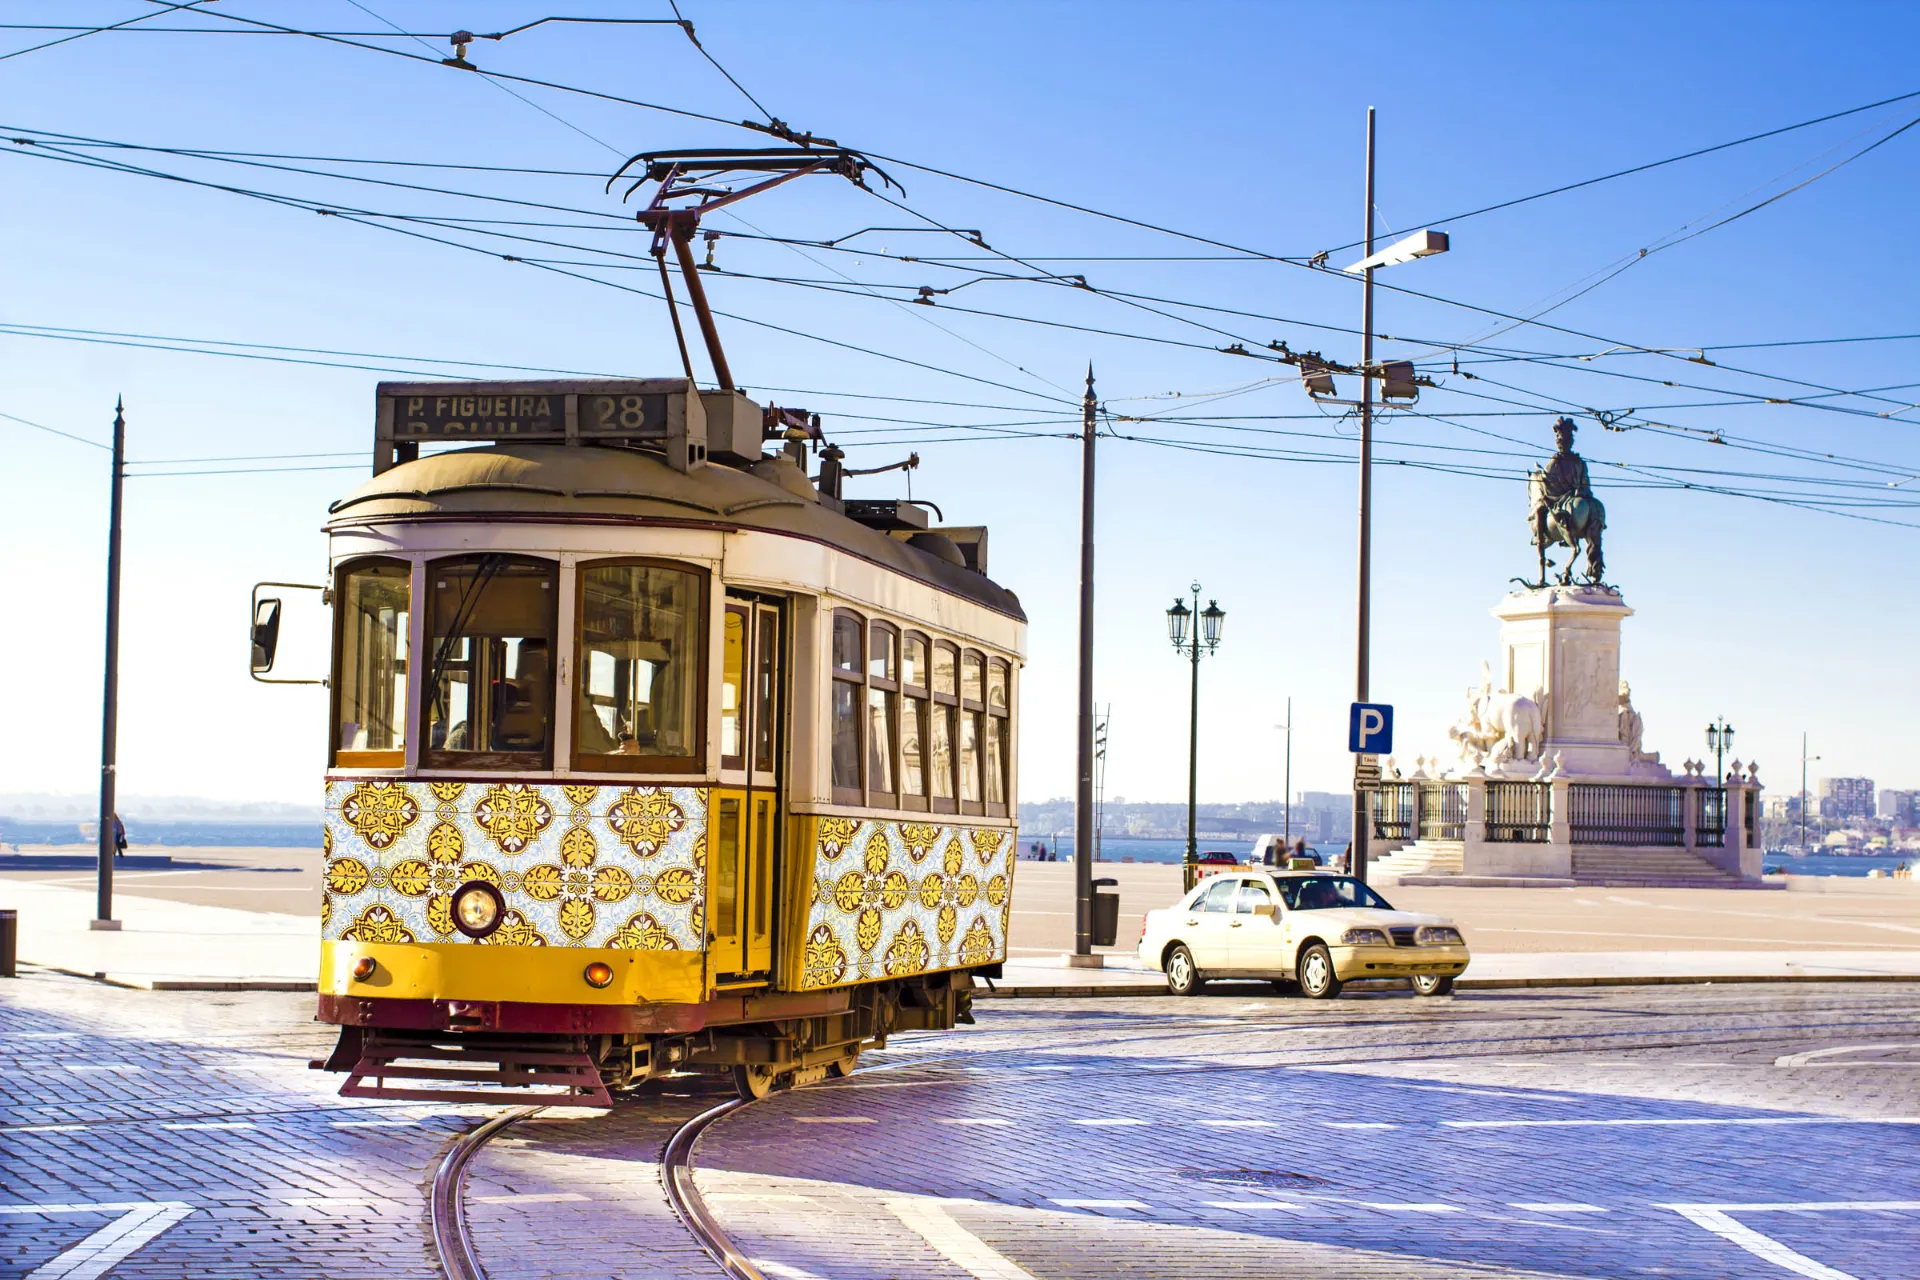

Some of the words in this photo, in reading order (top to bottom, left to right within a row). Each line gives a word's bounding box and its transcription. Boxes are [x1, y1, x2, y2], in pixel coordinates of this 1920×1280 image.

[407, 396, 425, 417] P.
[436, 396, 552, 417] FIGUEIRA
[597, 395, 645, 430] 28
[1359, 709, 1384, 748] P
